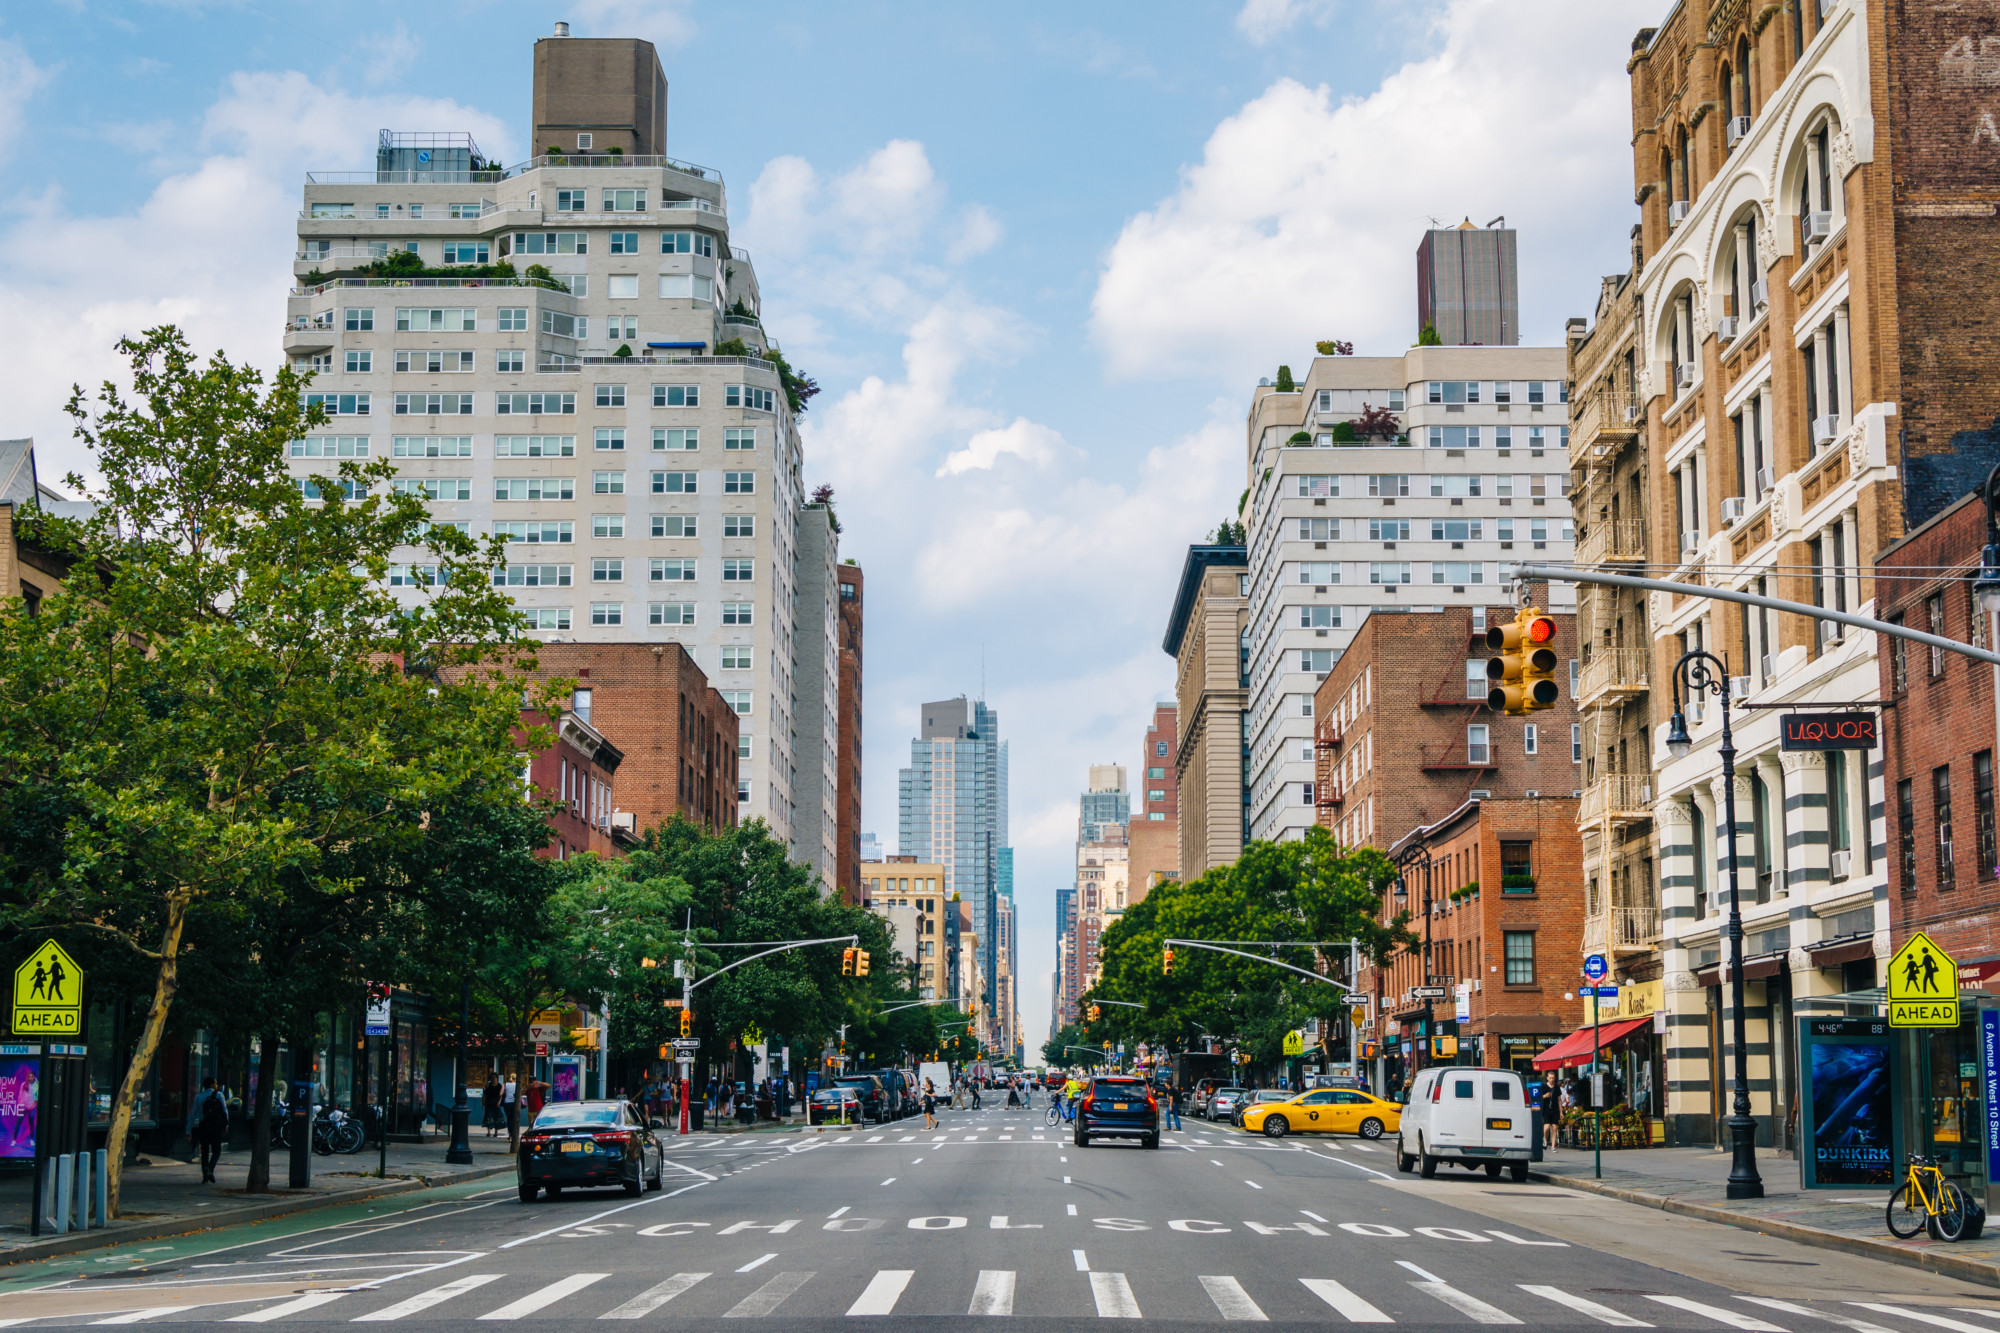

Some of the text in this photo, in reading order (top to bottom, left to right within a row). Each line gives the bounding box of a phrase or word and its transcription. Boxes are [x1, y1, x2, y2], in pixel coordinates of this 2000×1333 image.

[1788, 720, 1875, 742] LIQUOR
[1628, 991, 1645, 1015] Roast
[1895, 1007, 1953, 1019] AHEAD
[19, 1014, 75, 1026] AHEAD
[2, 1045, 29, 1054] TITAN
[1986, 1031, 1995, 1067] Avenue
[1532, 1088, 1539, 1097] P
[1988, 1079, 1998, 1104] West
[1310, 1112, 1318, 1120] T
[1989, 1107, 1999, 1118] 10
[1990, 1120, 2000, 1150] Street
[1817, 1147, 1891, 1160] DUNKIRK
[557, 1215, 1572, 1248] SCHOOL SCHOOL
